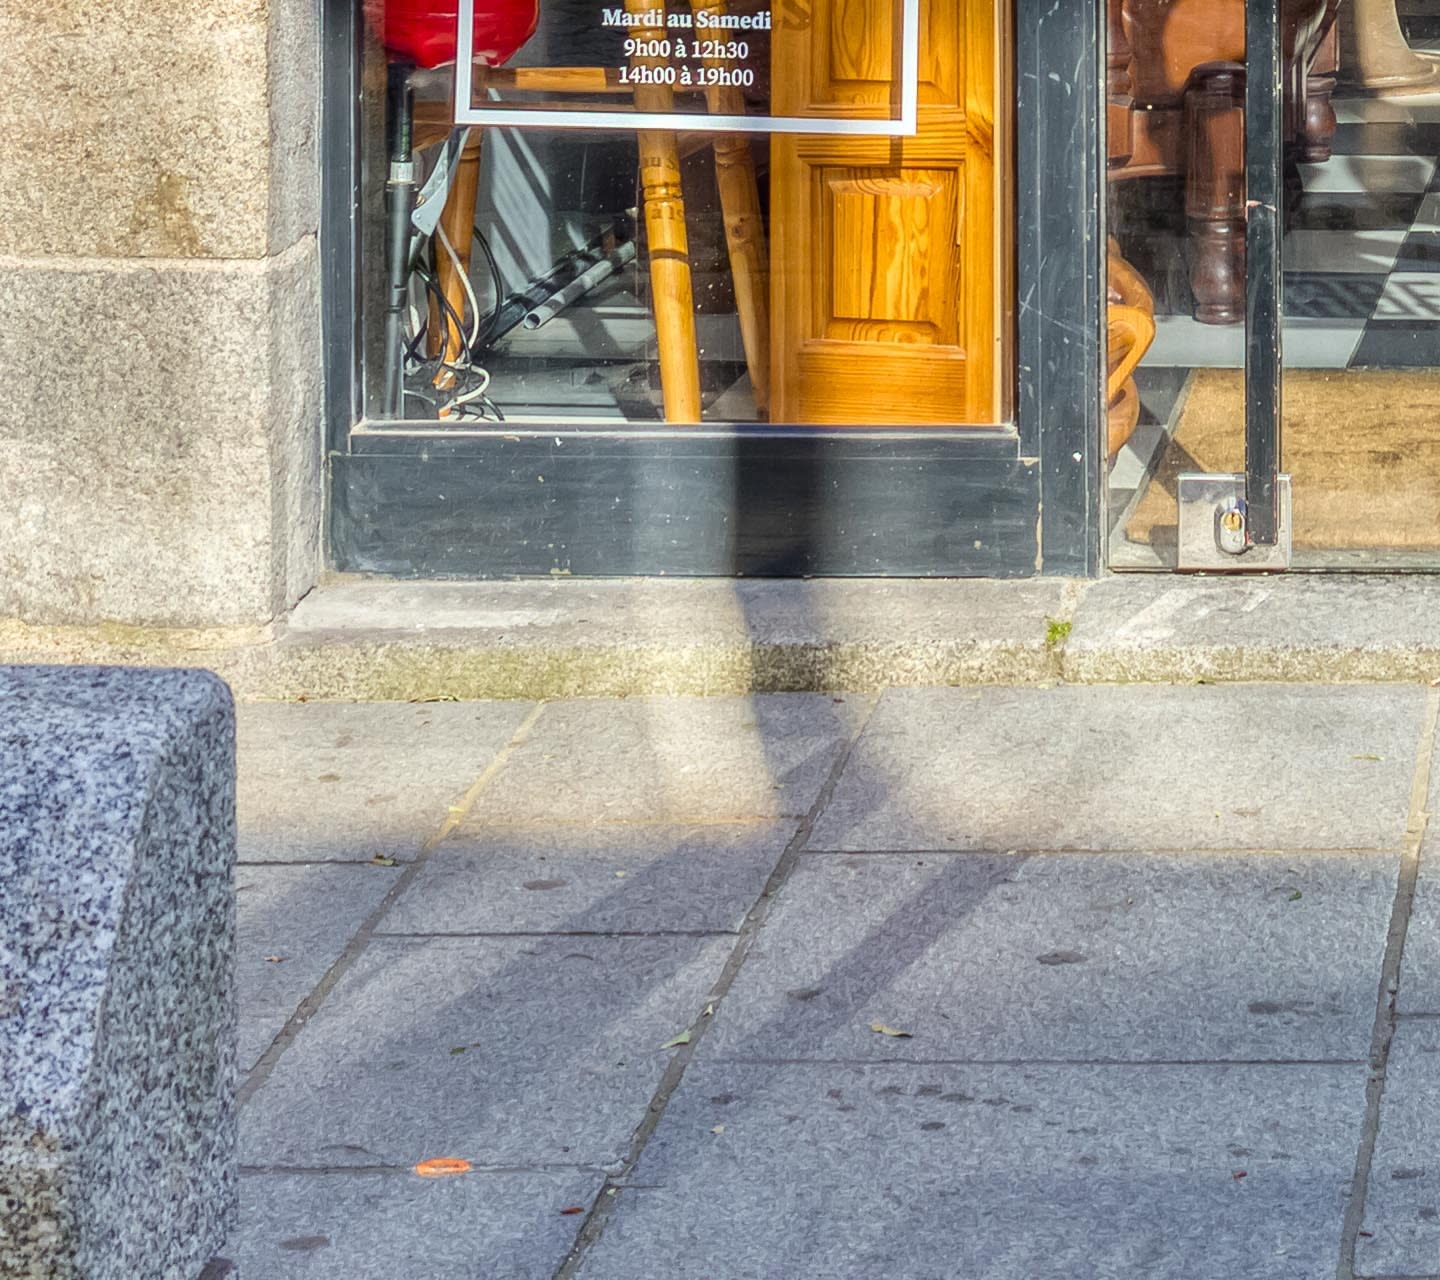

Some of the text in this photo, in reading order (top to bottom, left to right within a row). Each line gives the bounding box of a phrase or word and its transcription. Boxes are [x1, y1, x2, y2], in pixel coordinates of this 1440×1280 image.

[602, 7, 772, 30] Mardi au Samedi
[623, 38, 750, 60] 9h00 à 12h30
[618, 65, 755, 87] 14h00 à 19h00
